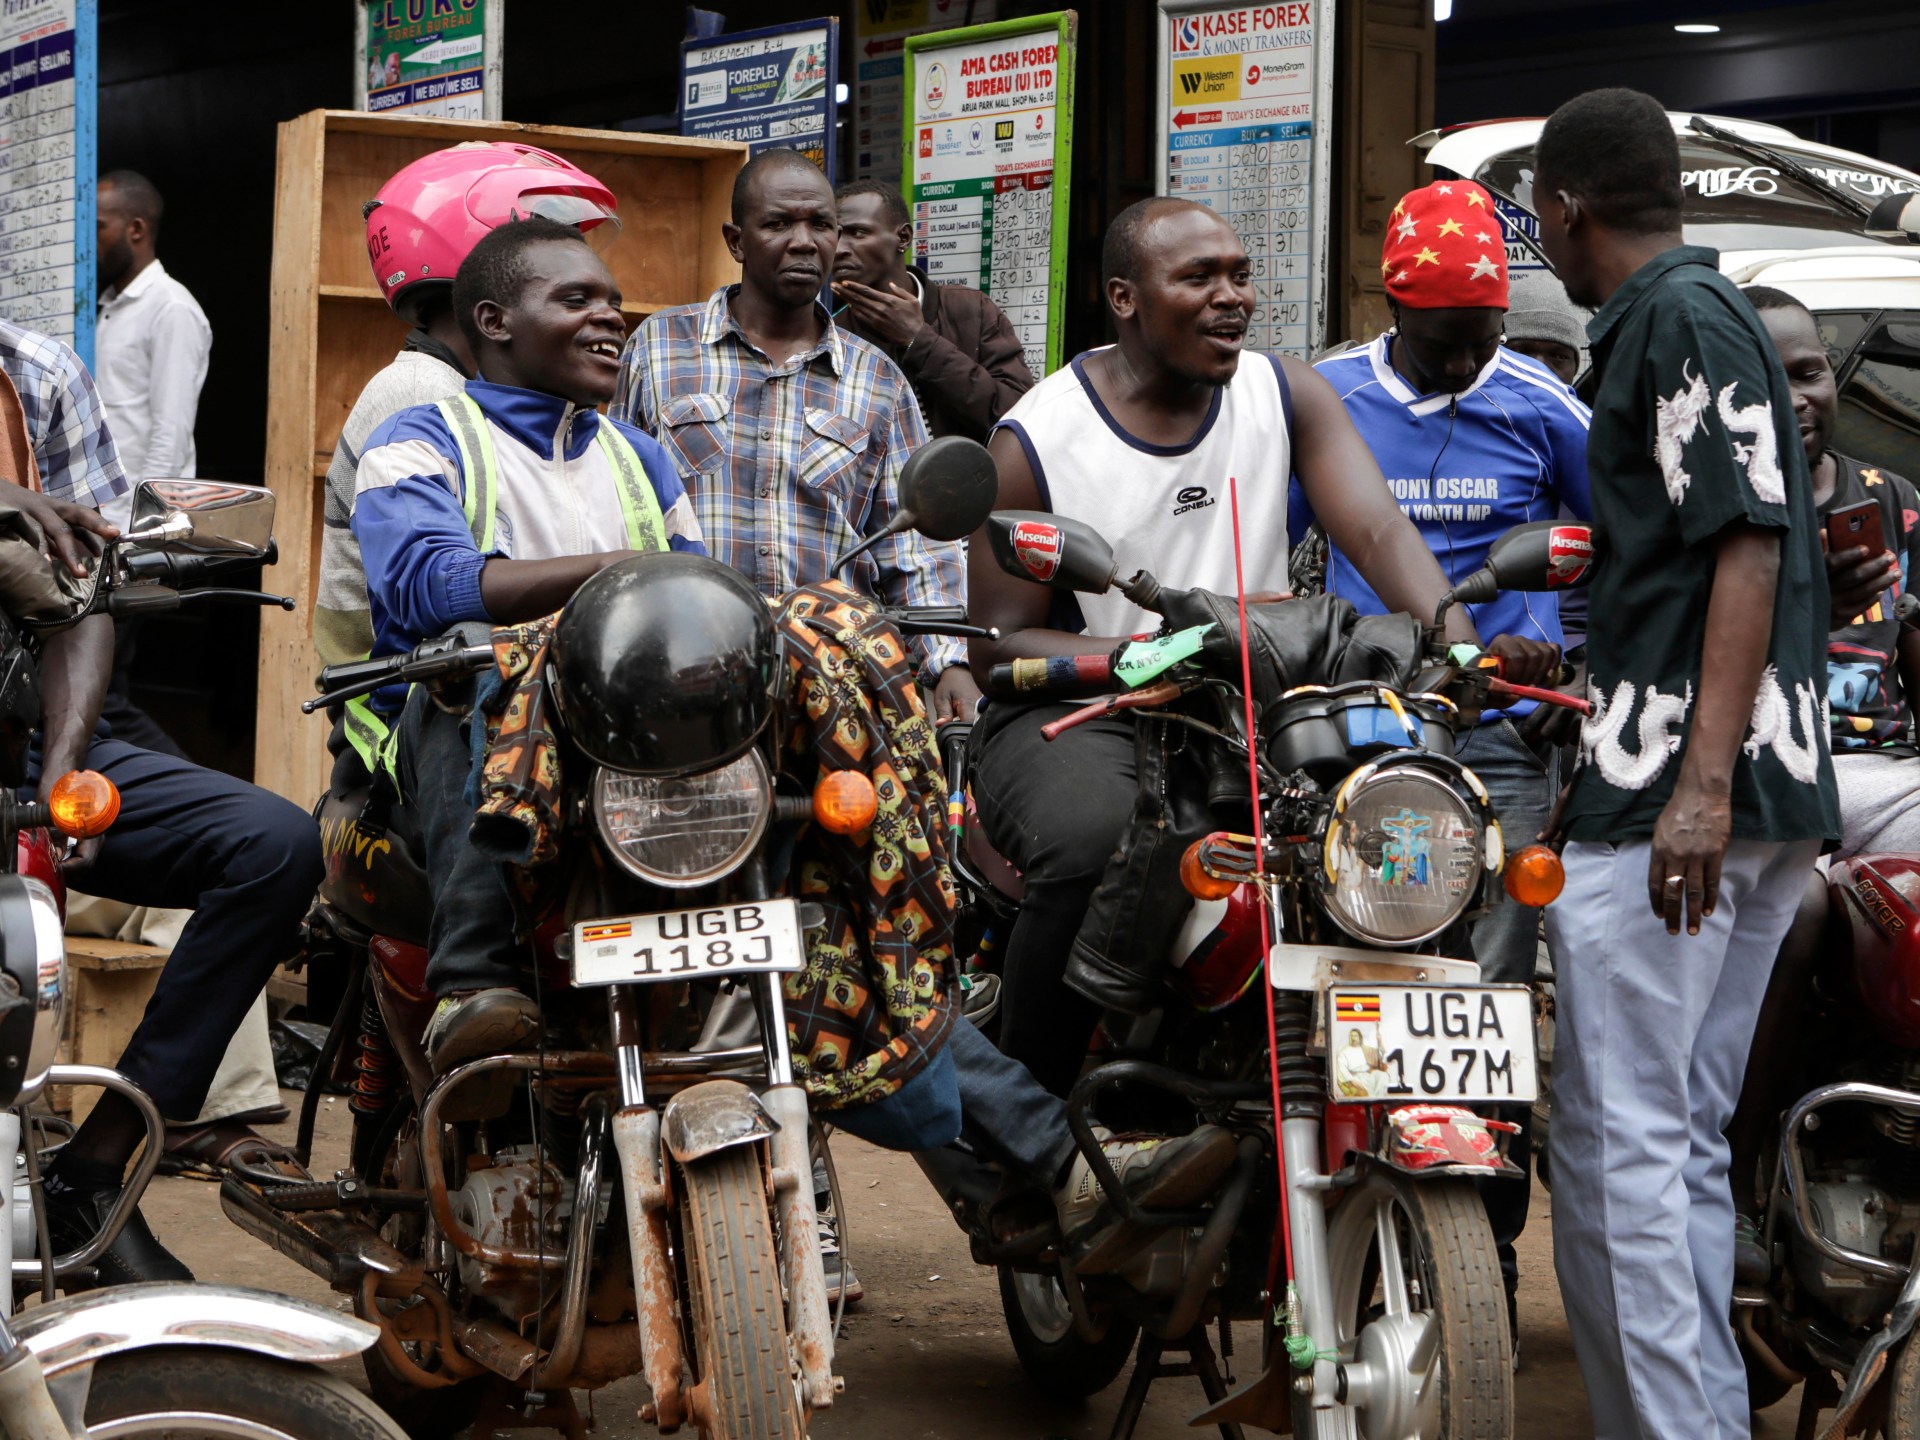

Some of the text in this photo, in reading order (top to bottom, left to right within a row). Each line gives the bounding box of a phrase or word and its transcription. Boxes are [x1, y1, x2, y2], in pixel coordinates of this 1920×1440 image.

[388, 25, 422, 42] FOREX
[427, 12, 472, 33] BUREAU
[1203, 11, 1247, 37] KASE
[1253, 3, 1310, 31] FOREX
[1203, 30, 1312, 56] & MONEY TRANSFERS
[40, 49, 71, 72] SELLING
[701, 39, 783, 65] BASEMENT B-4
[960, 44, 1058, 77] AMA CASH FOREX
[729, 63, 780, 86] FOREPLEX
[1204, 71, 1233, 81] Western
[1262, 62, 1305, 74] MoneyGram
[415, 83, 446, 100] WE BUY
[447, 76, 479, 93] WE SELL
[966, 70, 1053, 98] BUREAU (U) LTD
[1203, 83, 1225, 92] Union
[369, 91, 406, 111] CURRENCY
[961, 102, 977, 113] ARUA
[978, 100, 994, 111] PARK
[1012, 96, 1028, 107] SHOP
[749, 113, 760, 122] Very
[760, 110, 787, 120] Competitive
[1227, 110, 1253, 121] TODAY'S
[1255, 107, 1290, 119] EXCHANGE
[1292, 104, 1310, 115] RATE
[737, 125, 763, 140] RATES
[1026, 132, 1052, 142] MoneyGram
[1174, 126, 1299, 147] CURRENCY BUY SELL
[1183, 154, 1223, 165] US DOLLAR $
[1232, 143, 1268, 167] 3690
[1014, 160, 1040, 171] EXCHANGE
[921, 172, 931, 181] DATE
[1191, 175, 1209, 184] DOLLAR
[1217, 175, 1223, 185] $
[922, 175, 1053, 196] CURRENCY SIGN BUYING SELLING
[940, 204, 957, 212] DOLLAR
[994, 192, 1024, 211] 3690
[939, 223, 955, 231] DOLLAR
[940, 241, 957, 250] POUND
[930, 261, 943, 269] EURO
[389, 273, 401, 285] 1200
[1272, 303, 1299, 324] 240
[1436, 478, 1499, 500] OSCAR
[1413, 504, 1463, 521] YOUTH
[1467, 505, 1491, 521] MP
[1016, 528, 1057, 546] Arsenal
[1551, 536, 1594, 551] Arsena
[1136, 651, 1162, 668] NYC
[1856, 879, 1906, 936] BOXER
[657, 906, 764, 940] UGB
[633, 935, 773, 975] 118J
[1405, 992, 1504, 1038] UGA
[1386, 1048, 1514, 1094] 167M
